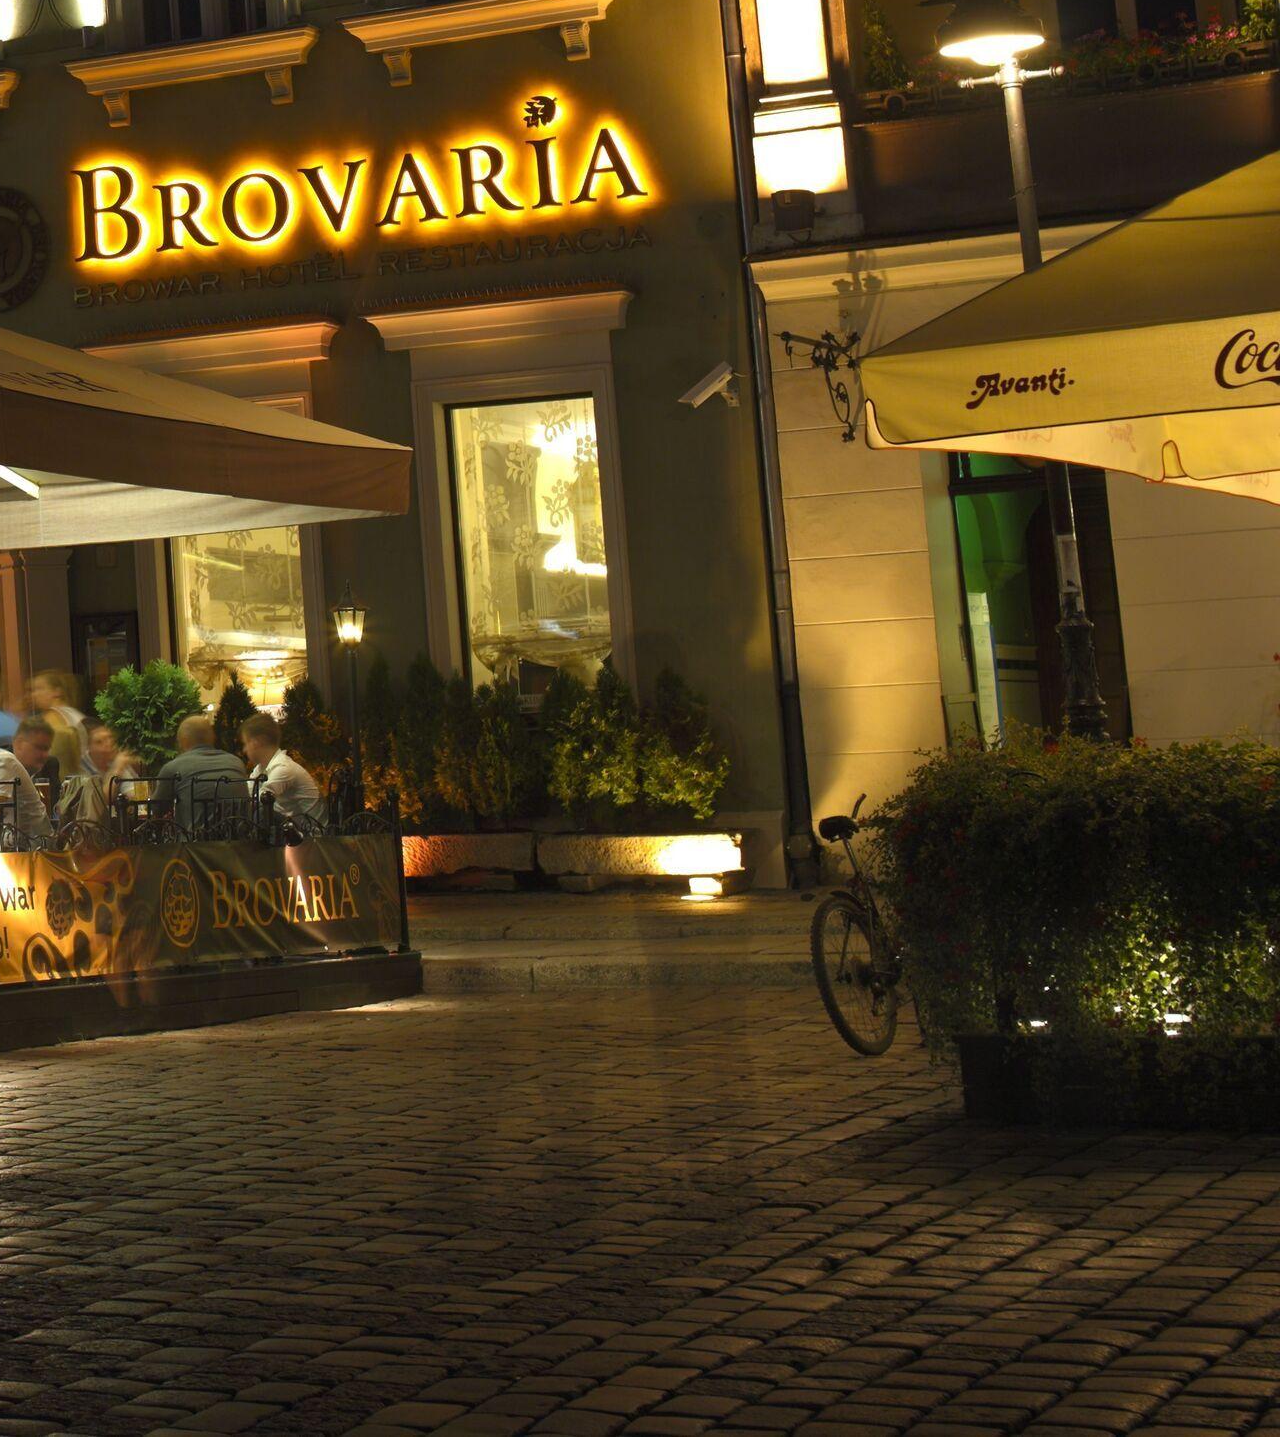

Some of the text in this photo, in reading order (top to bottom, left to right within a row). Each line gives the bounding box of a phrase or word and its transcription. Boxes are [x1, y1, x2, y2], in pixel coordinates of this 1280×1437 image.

[70, 127, 650, 263] BROVARIA
[72, 272, 221, 309] BROWAR
[377, 225, 654, 277] RESTAURACJA
[1213, 328, 1280, 389] Coc
